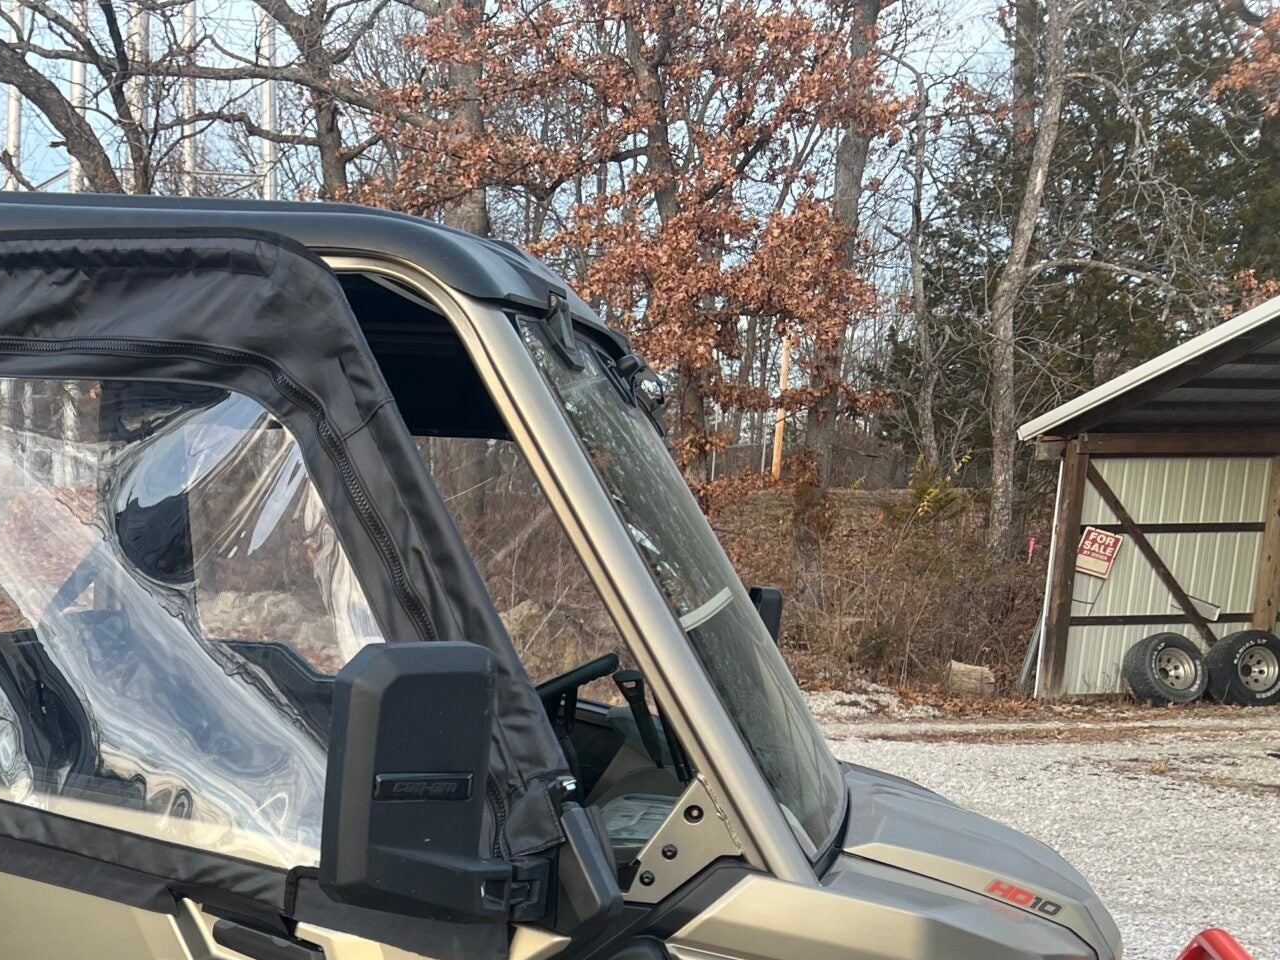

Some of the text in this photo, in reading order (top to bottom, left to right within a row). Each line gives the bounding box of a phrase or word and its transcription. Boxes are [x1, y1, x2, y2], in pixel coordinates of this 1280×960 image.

[1089, 532, 1116, 547] FOR
[1083, 540, 1115, 557] SALE
[393, 782, 458, 793] can-am
[986, 880, 1062, 916] HD10
